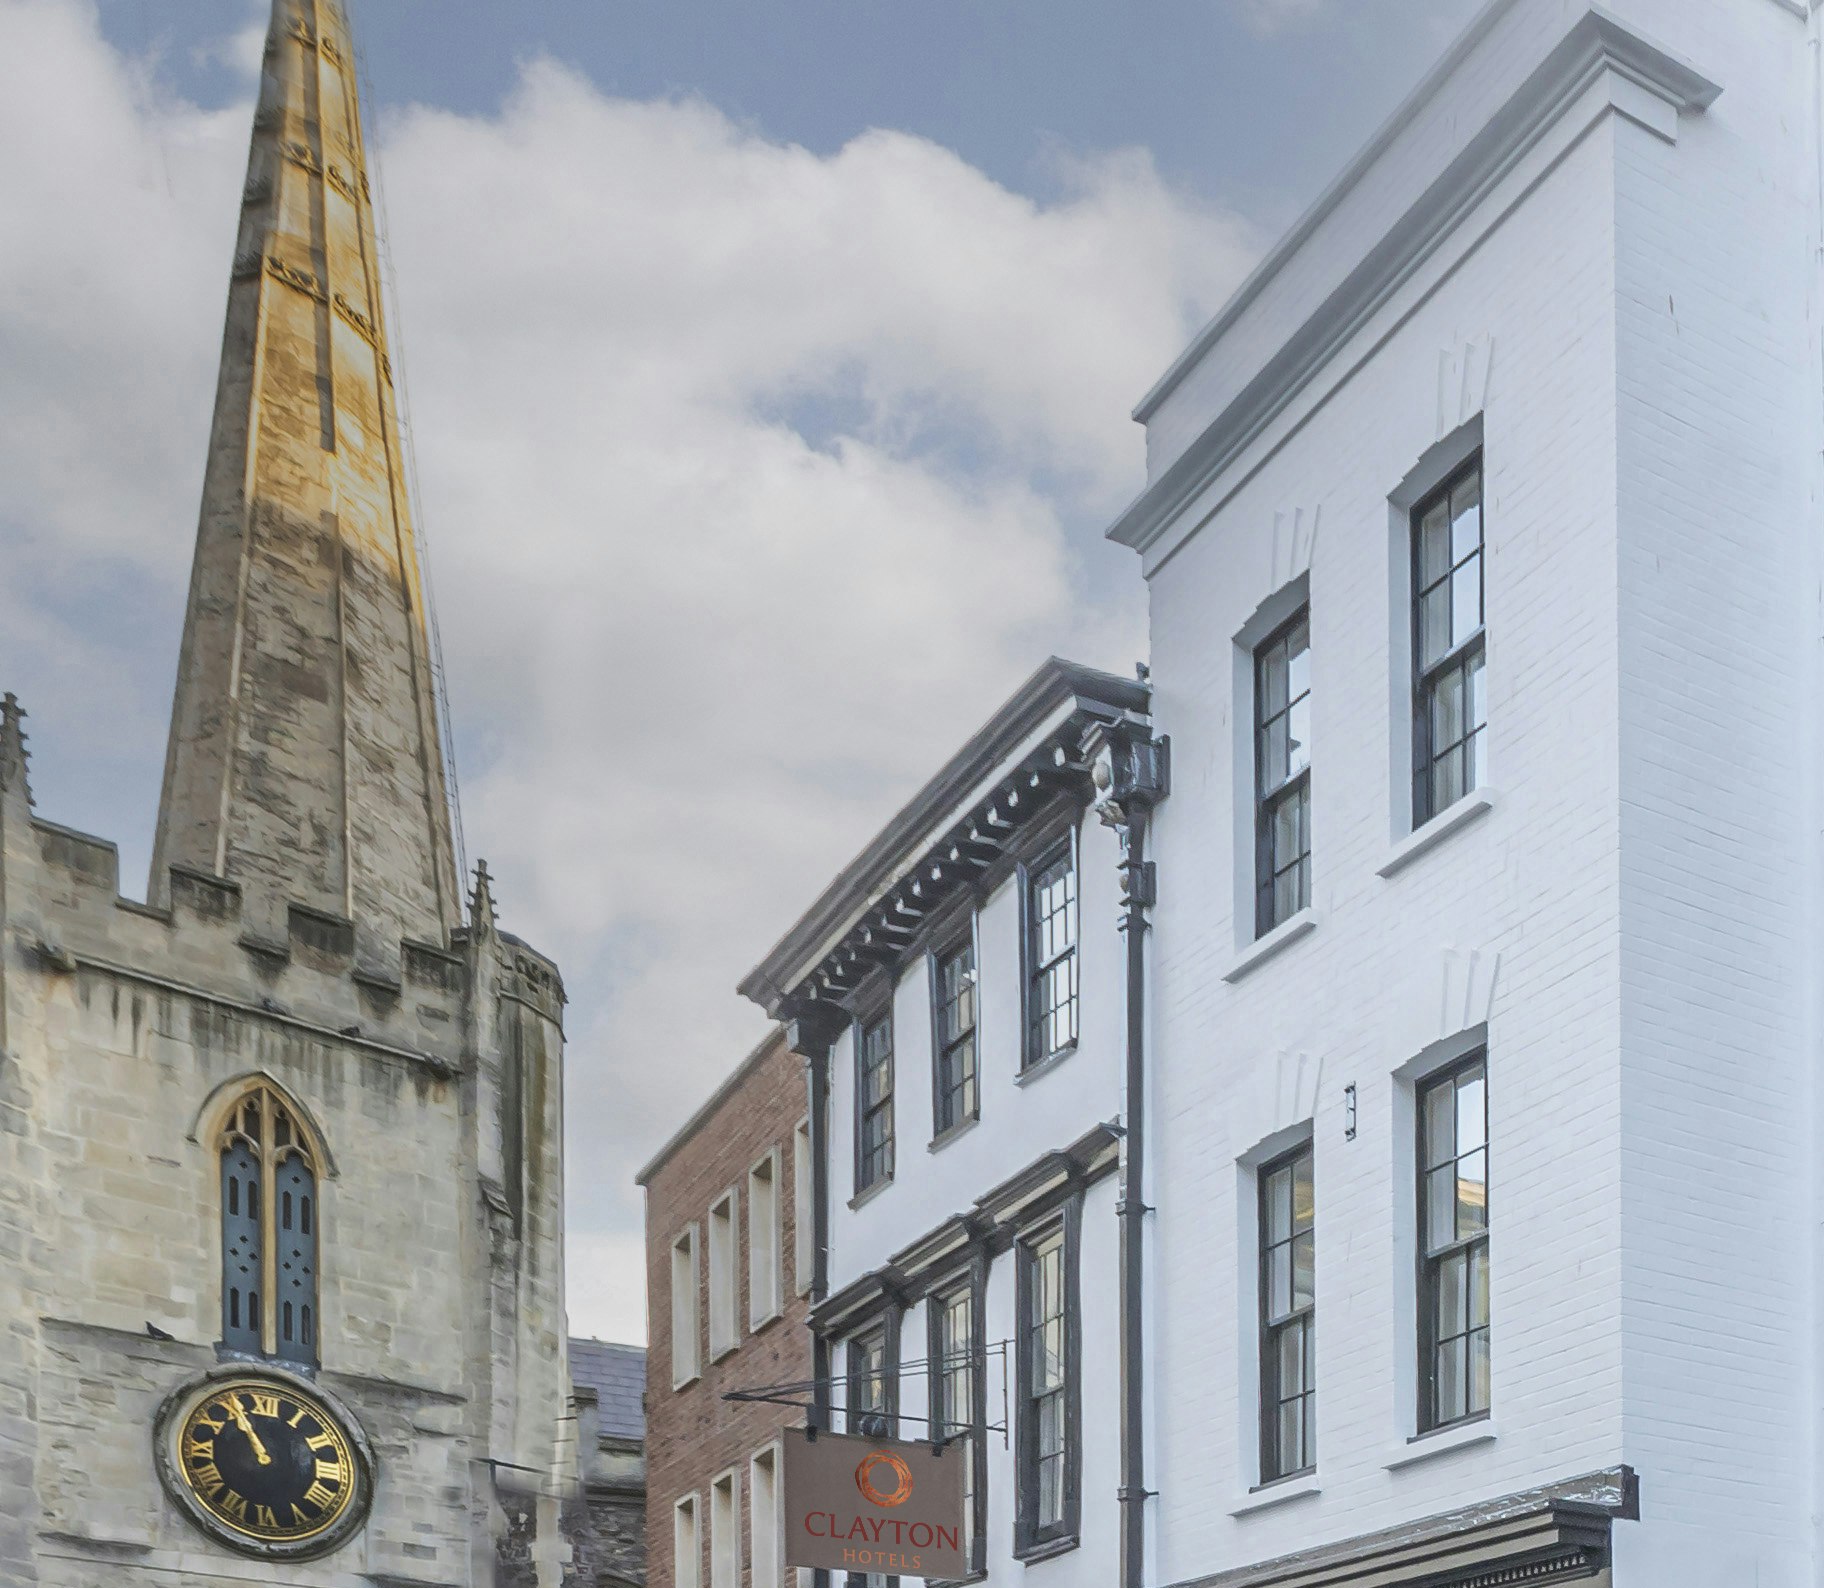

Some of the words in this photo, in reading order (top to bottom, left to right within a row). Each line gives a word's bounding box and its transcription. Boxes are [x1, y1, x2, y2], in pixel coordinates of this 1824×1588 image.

[251, 1393, 280, 1418] XII
[286, 1408, 307, 1428] I
[305, 1432, 334, 1452] II
[315, 1458, 341, 1481] III
[255, 1504, 280, 1528] VI
[290, 1502, 309, 1526] V
[804, 1511, 958, 1551] CLAYTON
[843, 1548, 921, 1569] HOTELS
